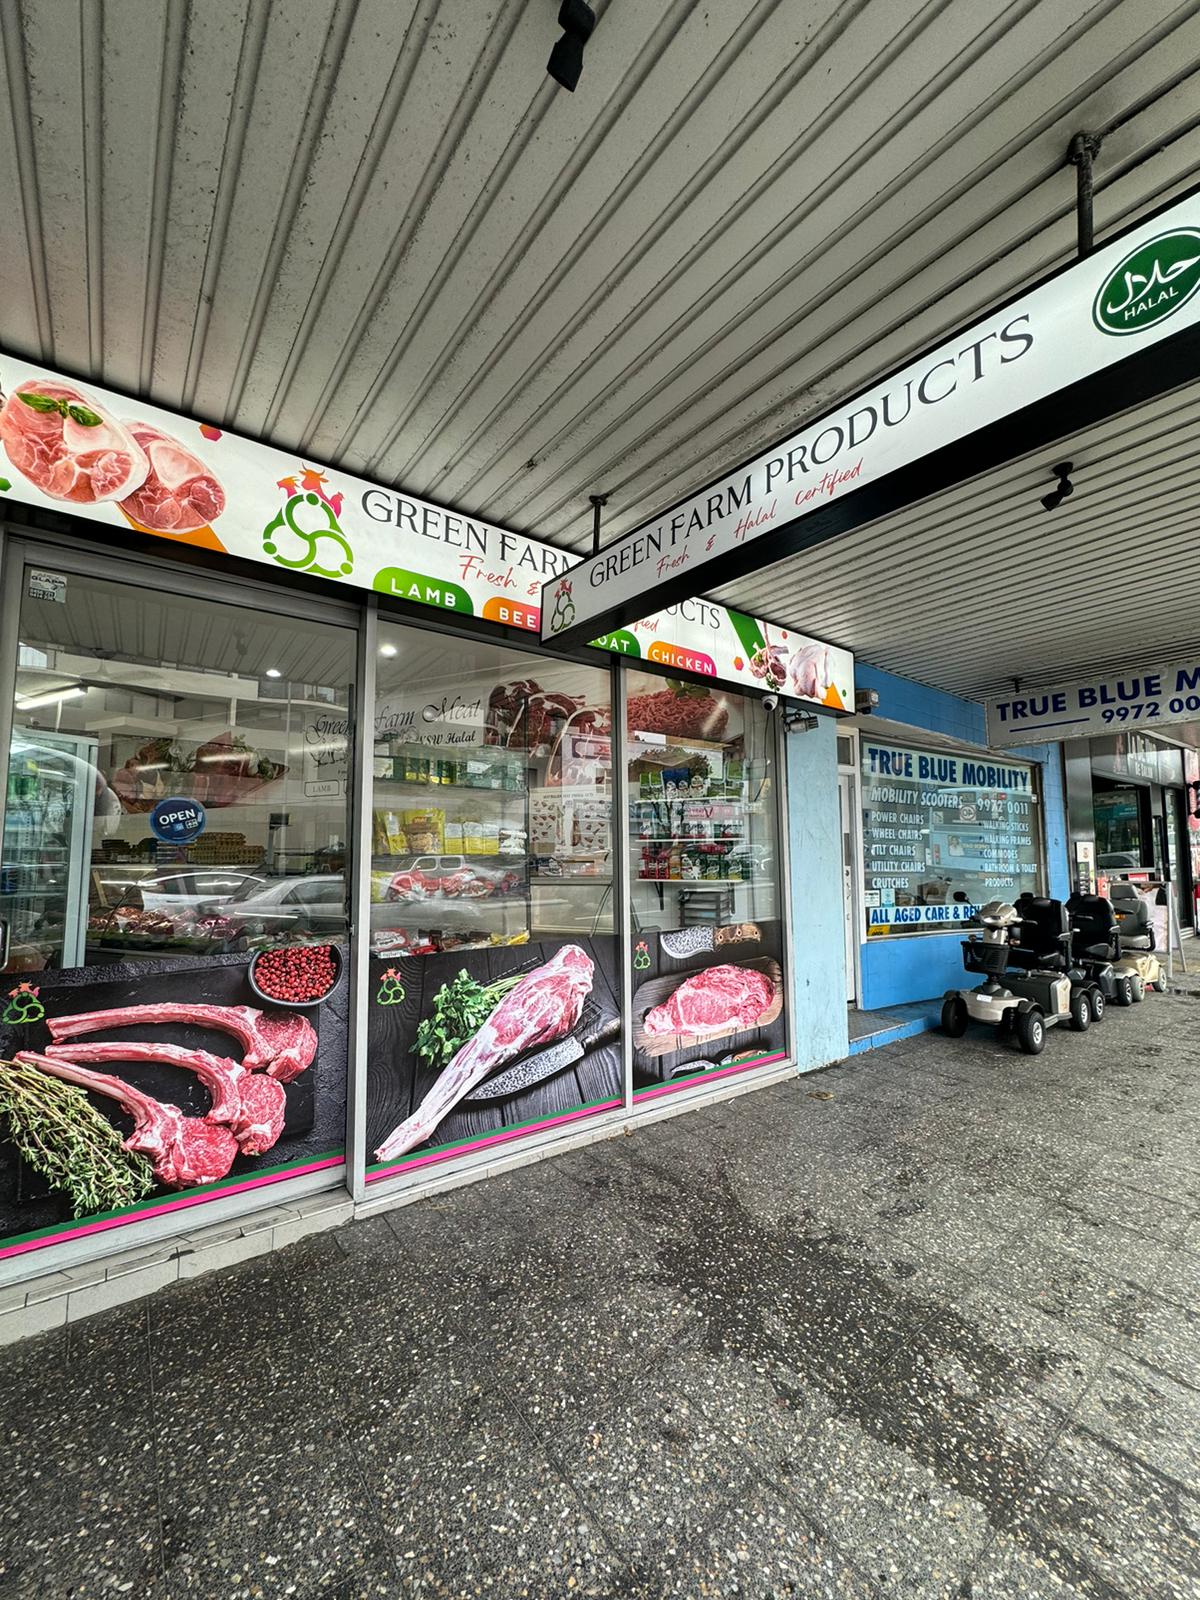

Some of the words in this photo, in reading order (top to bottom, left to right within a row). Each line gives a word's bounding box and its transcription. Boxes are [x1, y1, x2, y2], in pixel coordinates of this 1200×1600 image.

[1124, 287, 1179, 321] HALAL
[589, 526, 665, 589] GREEN
[669, 474, 753, 546] FARM
[763, 313, 1035, 495] PRODUCTS
[361, 489, 489, 555] GREEN
[656, 545, 690, 579] Fresh
[705, 534, 717, 552] &
[733, 499, 778, 541] Halal
[458, 554, 518, 588] Fresh
[527, 580, 541, 596] &
[391, 577, 457, 607] LAMB
[499, 607, 537, 629] BEE
[591, 635, 630, 652] OAT
[651, 649, 713, 674] CHICKEN
[996, 693, 1067, 721] TRUE
[1078, 674, 1162, 708] BLUE
[306, 714, 349, 744] Gree
[422, 696, 480, 723] Meat
[1101, 701, 1161, 723] 9972
[445, 730, 476, 744] Halal
[868, 747, 913, 778] TRUE
[918, 755, 957, 784] BLUE
[962, 762, 1029, 792] MOBILITY
[871, 785, 919, 805] MOBILITY
[920, 790, 964, 809] SCOOTERS
[1007, 801, 1029, 815] 0011
[159, 809, 195, 825] OPEN
[871, 811, 898, 823] POWER
[900, 812, 924, 825] CHAIRS
[871, 827, 896, 840] WHEEL
[898, 828, 923, 841] CHAIRS
[1011, 822, 1029, 832] STICKS
[1010, 835, 1032, 846] FRAMES
[889, 844, 916, 857] CHAIRS
[983, 849, 1018, 859] COMMODES
[871, 860, 898, 872] UTILITY
[900, 861, 926, 873] CHAIRS
[1021, 863, 1038, 873] TOILET
[871, 877, 909, 889] CRUTCHES
[984, 877, 1014, 888] PRODUCTS
[871, 909, 890, 923] ALL
[894, 907, 921, 923] AGED
[925, 906, 950, 921] CARE
[952, 906, 960, 919] &
